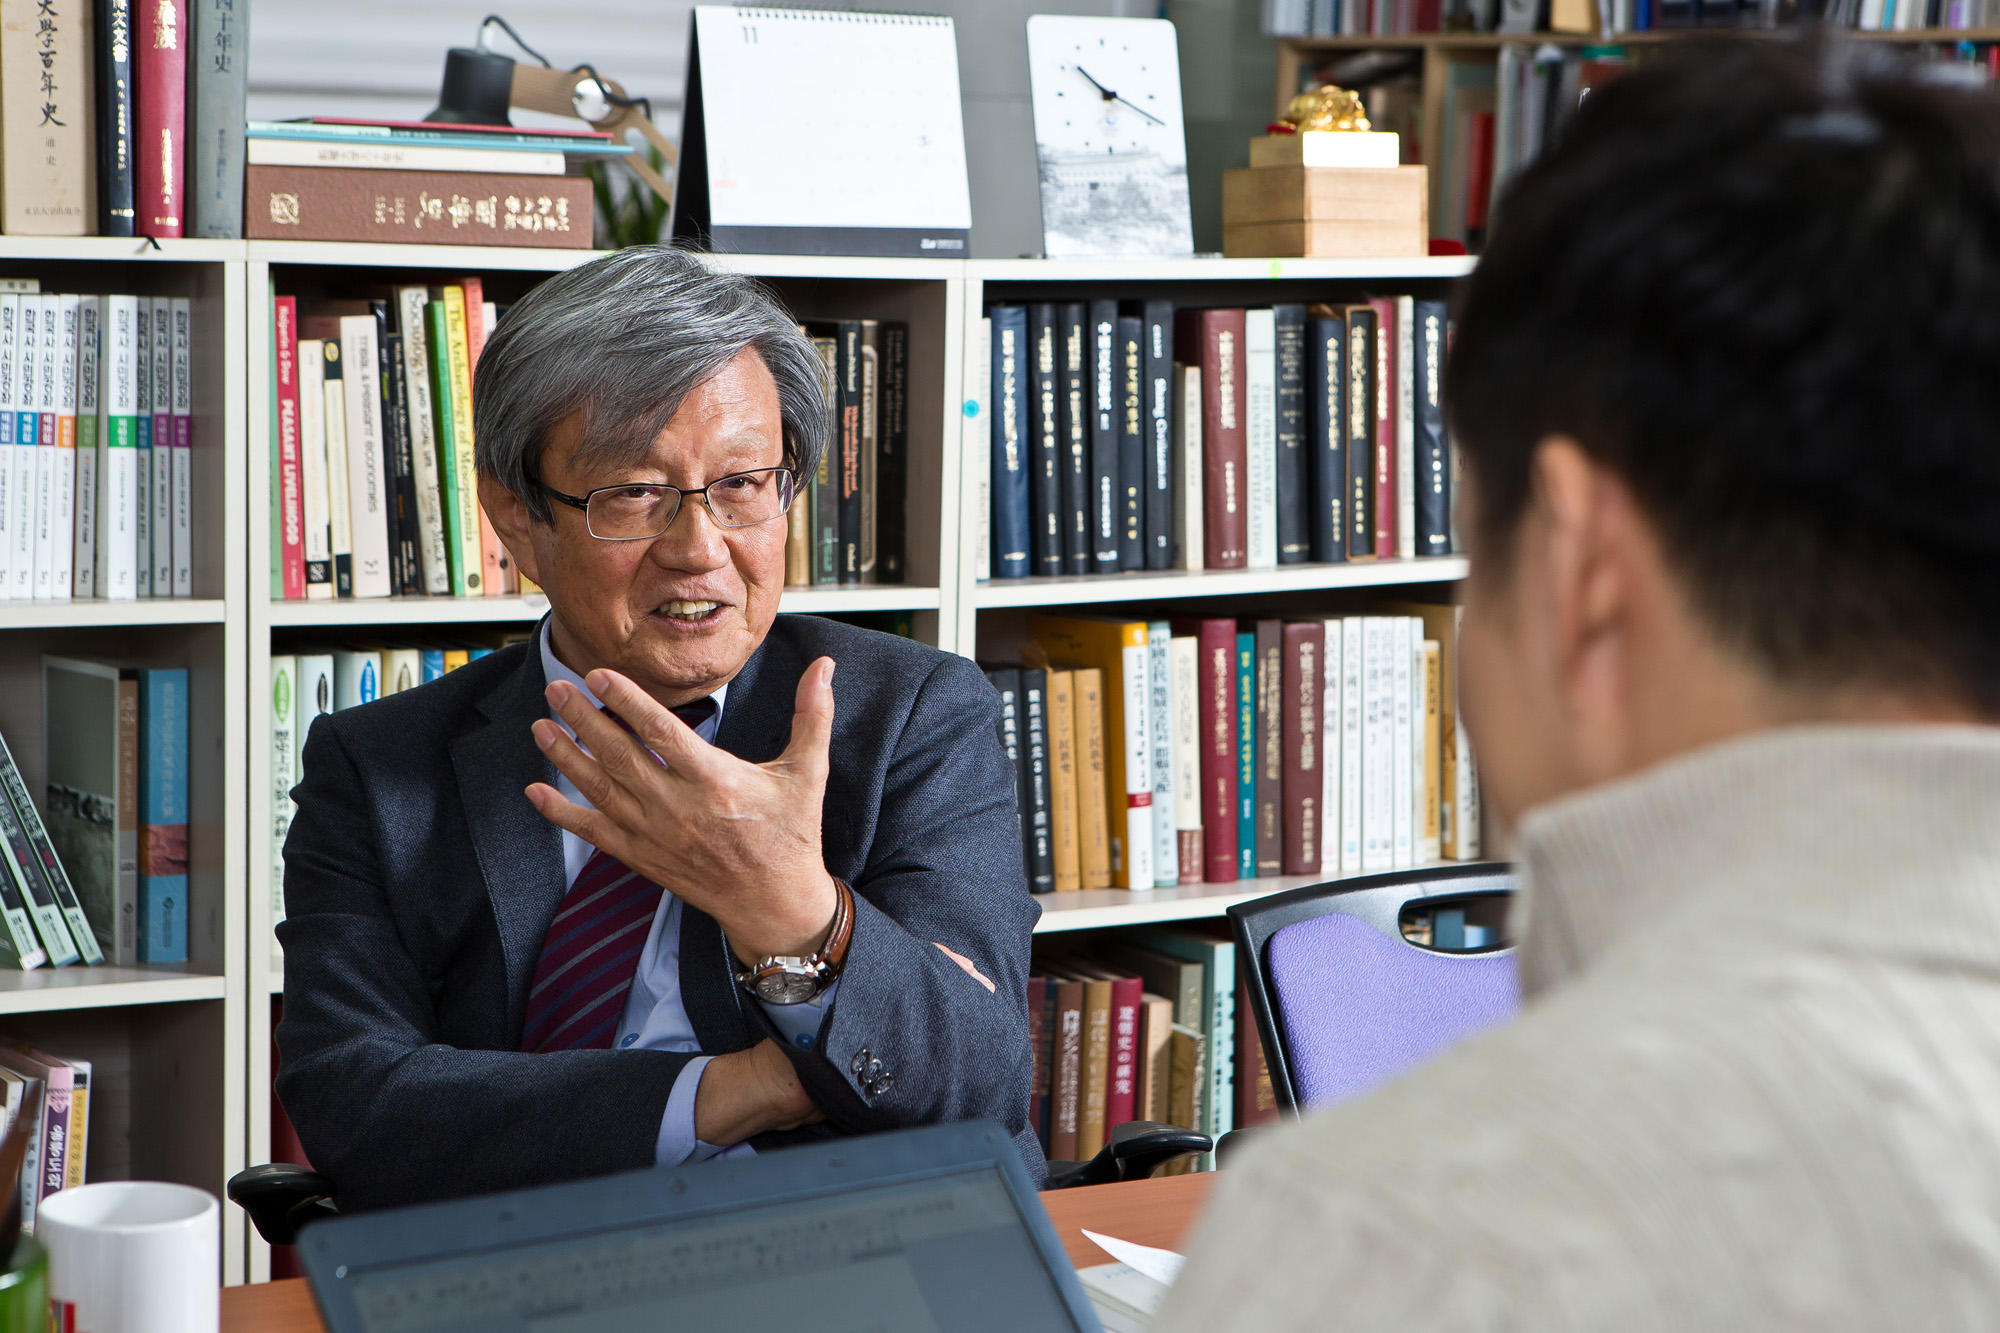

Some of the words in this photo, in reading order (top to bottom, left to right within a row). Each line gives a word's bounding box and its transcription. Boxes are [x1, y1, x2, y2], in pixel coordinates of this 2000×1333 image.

[742, 26, 758, 44] 11
[449, 307, 461, 335] The
[451, 339, 467, 426] Archaeology
[1263, 384, 1272, 412] THE
[281, 399, 297, 462] PEASANT
[1251, 383, 1262, 448] CHINESE
[1263, 417, 1272, 482] ORIGINS
[283, 463, 299, 546] LIVELIHOOD
[458, 450, 475, 543] Mesopotamia
[1251, 453, 1262, 558] CIVILIZATION
